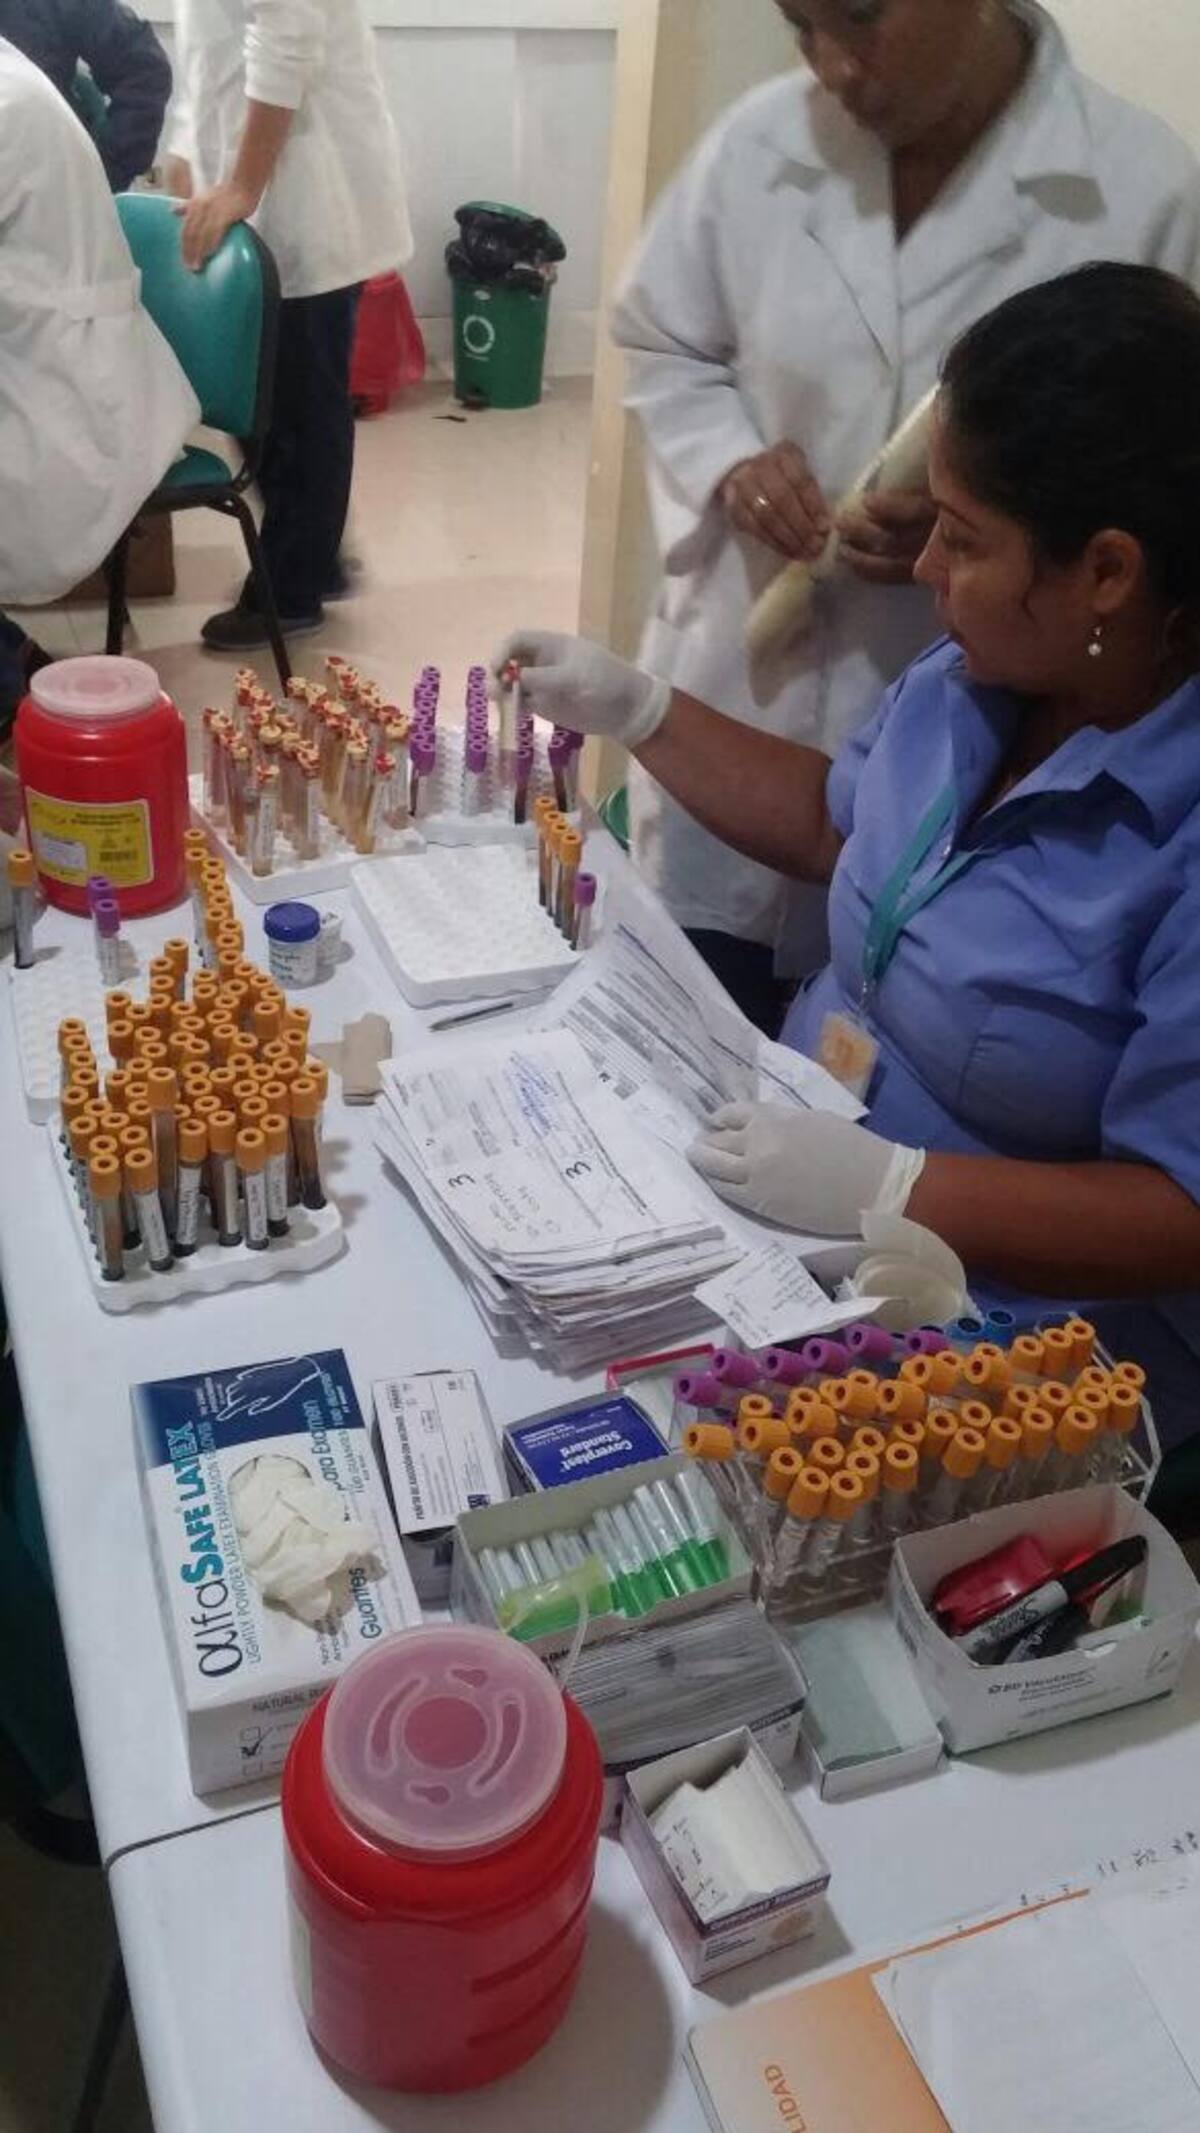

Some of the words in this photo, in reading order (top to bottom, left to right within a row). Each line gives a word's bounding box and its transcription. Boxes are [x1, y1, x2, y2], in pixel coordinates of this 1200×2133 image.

[302, 1400, 331, 1454] Examen
[560, 1431, 621, 1457] Standard
[165, 1420, 206, 1501] LATEX
[562, 1440, 633, 1471] Coverplast
[206, 1462, 234, 1530] EXAMINATION
[221, 1534, 240, 1564] LATEX
[228, 1566, 249, 1616] POWDER
[348, 1567, 382, 1639] Guantes
[239, 1620, 261, 1663] LIGHTLY
